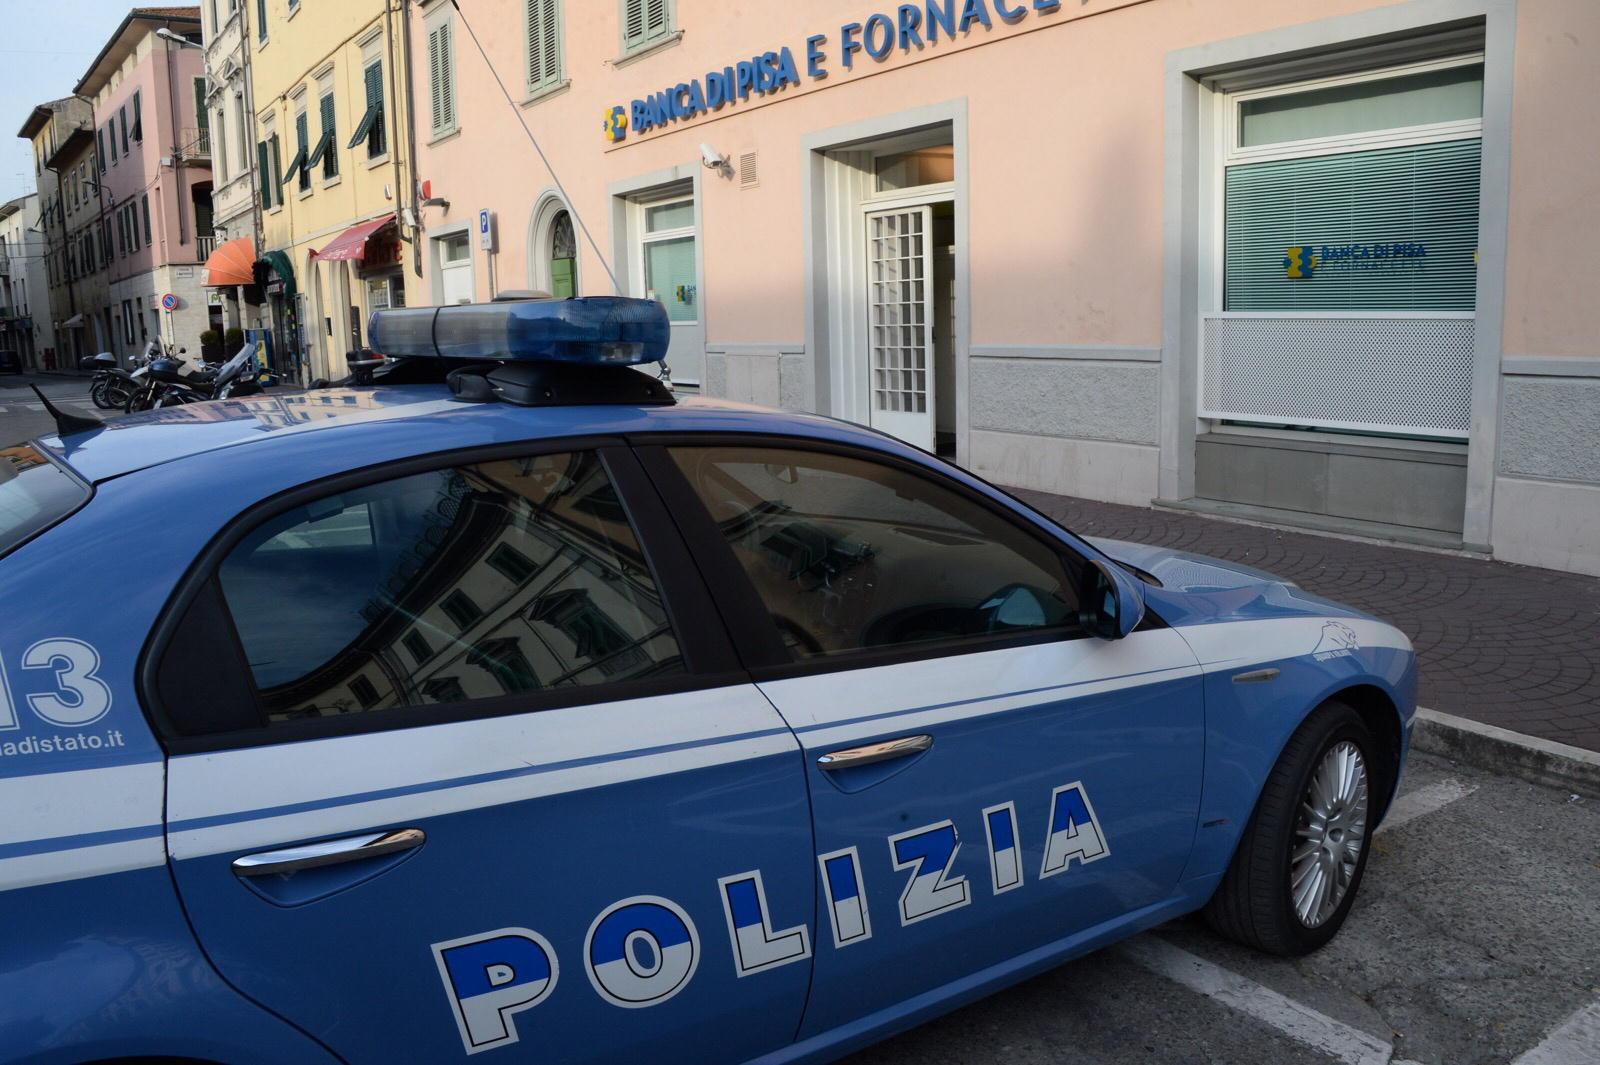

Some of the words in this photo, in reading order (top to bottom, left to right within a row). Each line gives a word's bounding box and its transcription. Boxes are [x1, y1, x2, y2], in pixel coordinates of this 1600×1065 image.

[631, 79, 707, 132] BANCA
[706, 66, 736, 108] DI
[737, 46, 799, 99] PISA
[806, 34, 827, 77] E
[1321, 243, 1370, 259] BANCA
[1373, 243, 1389, 258] DI
[1393, 241, 1426, 258] PISA
[431, 781, 1111, 1055] POLIZIA
